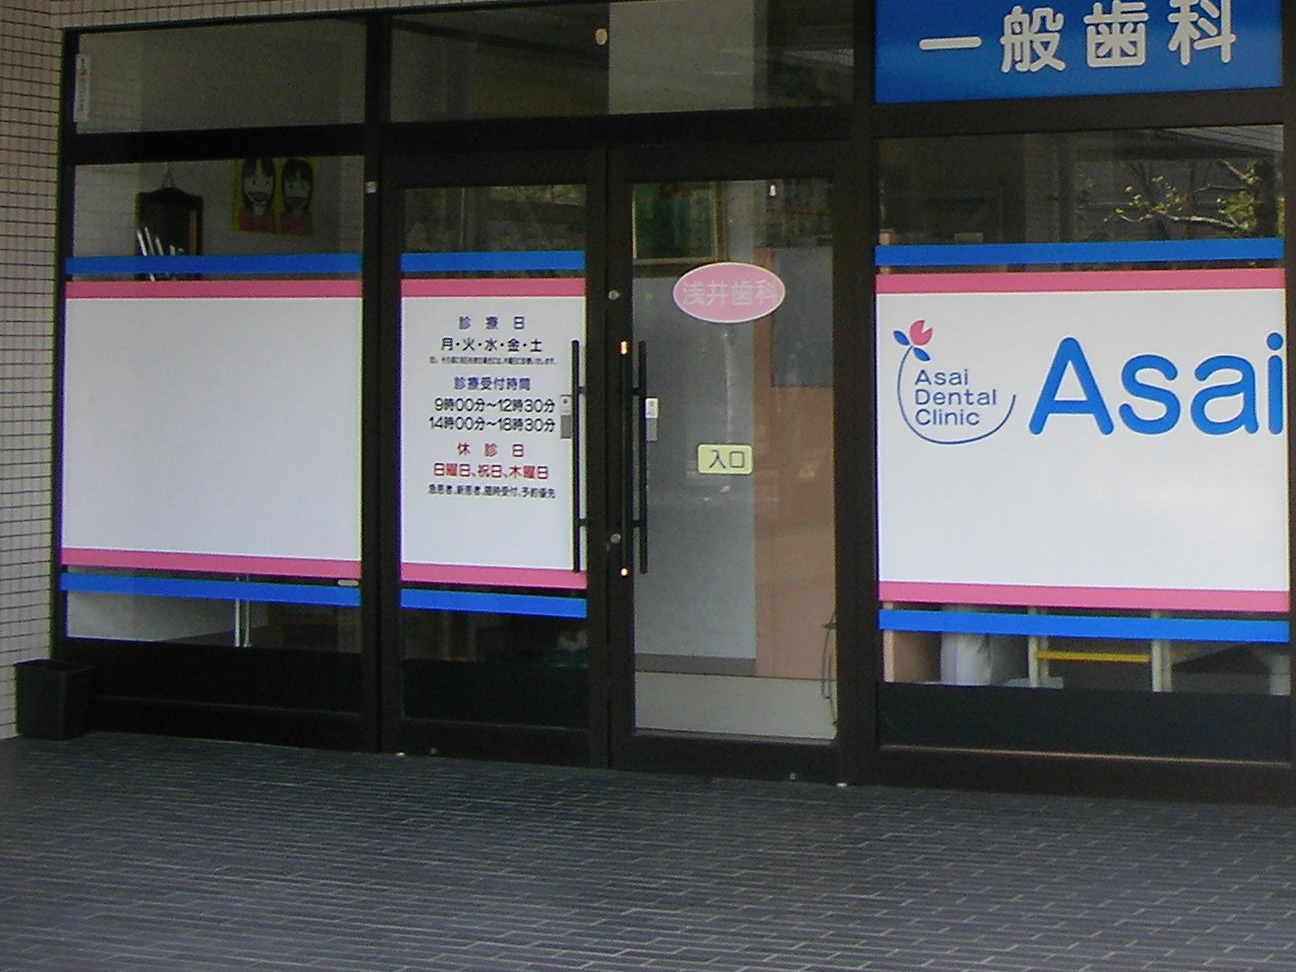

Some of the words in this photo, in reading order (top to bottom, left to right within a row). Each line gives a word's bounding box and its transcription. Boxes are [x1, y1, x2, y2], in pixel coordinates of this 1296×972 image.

[681, 279, 778, 307] 浅井歯科
[454, 376, 531, 391] 診療受付時間
[914, 368, 969, 386] Asai
[1028, 332, 1284, 436] Asai
[914, 388, 997, 406] Dental
[914, 408, 981, 426] Clinic
[709, 449, 746, 469] 入口
